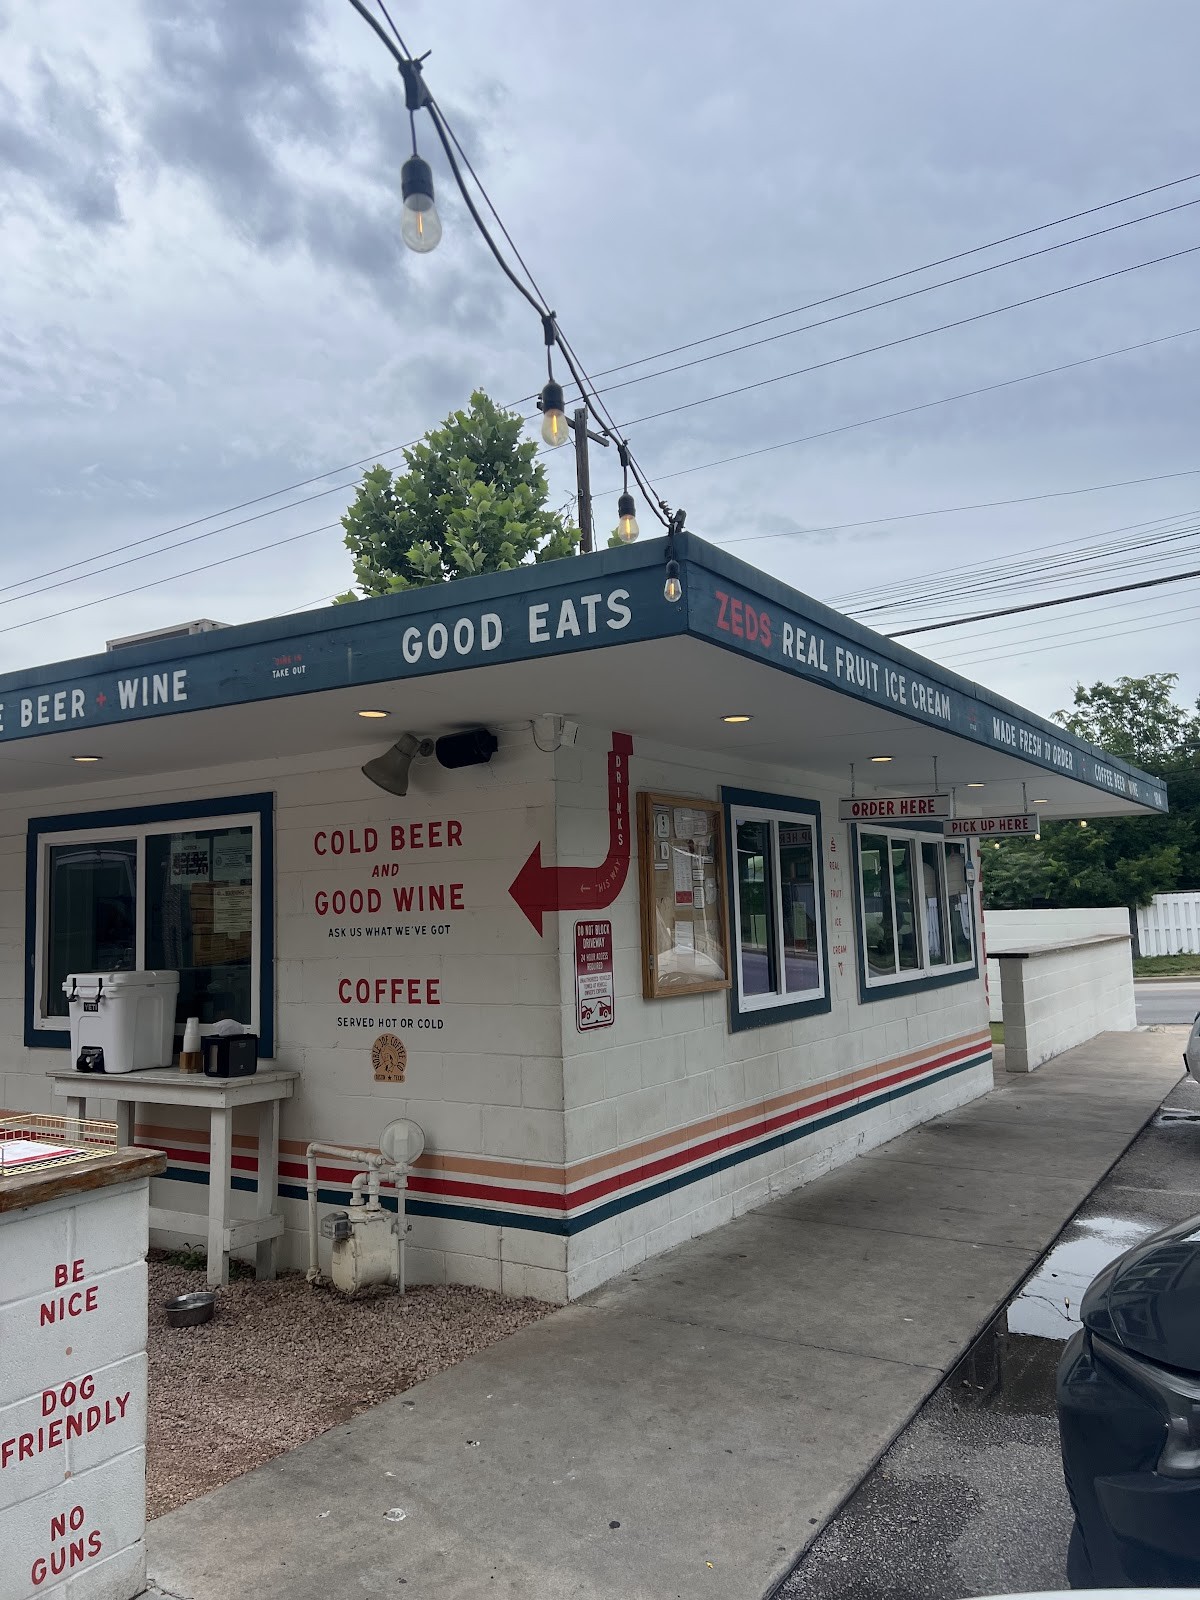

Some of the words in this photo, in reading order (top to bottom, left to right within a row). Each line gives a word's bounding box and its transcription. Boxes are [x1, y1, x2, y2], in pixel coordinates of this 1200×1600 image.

[402, 613, 501, 663] GOOD
[528, 589, 632, 643] EATS
[272, 668, 290, 678] TAKE
[292, 665, 306, 675] OUT
[715, 591, 772, 648] ZEDS
[781, 621, 828, 672] REAL
[836, 648, 879, 698] FRUIT
[885, 671, 907, 705] ICE
[911, 681, 950, 722] CREAM
[20, 689, 86, 728] BEER
[118, 669, 188, 710] WINE
[992, 717, 1017, 747] MADE
[1019, 728, 1042, 758] FRESH
[1052, 745, 1073, 770] ORDER
[615, 755, 624, 846] DRINKS
[852, 799, 895, 816] ORDER
[900, 798, 935, 814] HERE
[314, 828, 378, 856] COLD
[391, 820, 463, 851] BEER
[951, 820, 978, 833] PICK
[980, 819, 996, 831] UP
[999, 817, 1029, 831] HERE
[371, 863, 400, 878] AND
[609, 859, 621, 881] WAY
[315, 888, 382, 915] GOOD
[393, 883, 465, 912] WINE
[328, 927, 347, 938] ASK
[350, 927, 362, 937] US
[365, 926, 392, 937] WHAT
[396, 925, 427, 936] WE'VE
[431, 924, 451, 935] GOT
[577, 925, 584, 936] DO
[585, 925, 594, 936] NOT
[595, 924, 610, 935] BLOCK
[832, 945, 847, 954] CREAM
[338, 978, 441, 1005] COFFEE
[85, 1003, 97, 1011] YETI
[337, 1016, 374, 1028] SERVED
[378, 1017, 397, 1028] HOT
[400, 1018, 414, 1028] OR
[417, 1018, 444, 1030] COLD
[54, 1259, 85, 1288] BE
[40, 1286, 99, 1326] NICE
[41, 1374, 95, 1417] DOG
[1, 1391, 131, 1469] FRIENDLY
[50, 1505, 85, 1542] NO
[31, 1530, 102, 1586] GUNS
